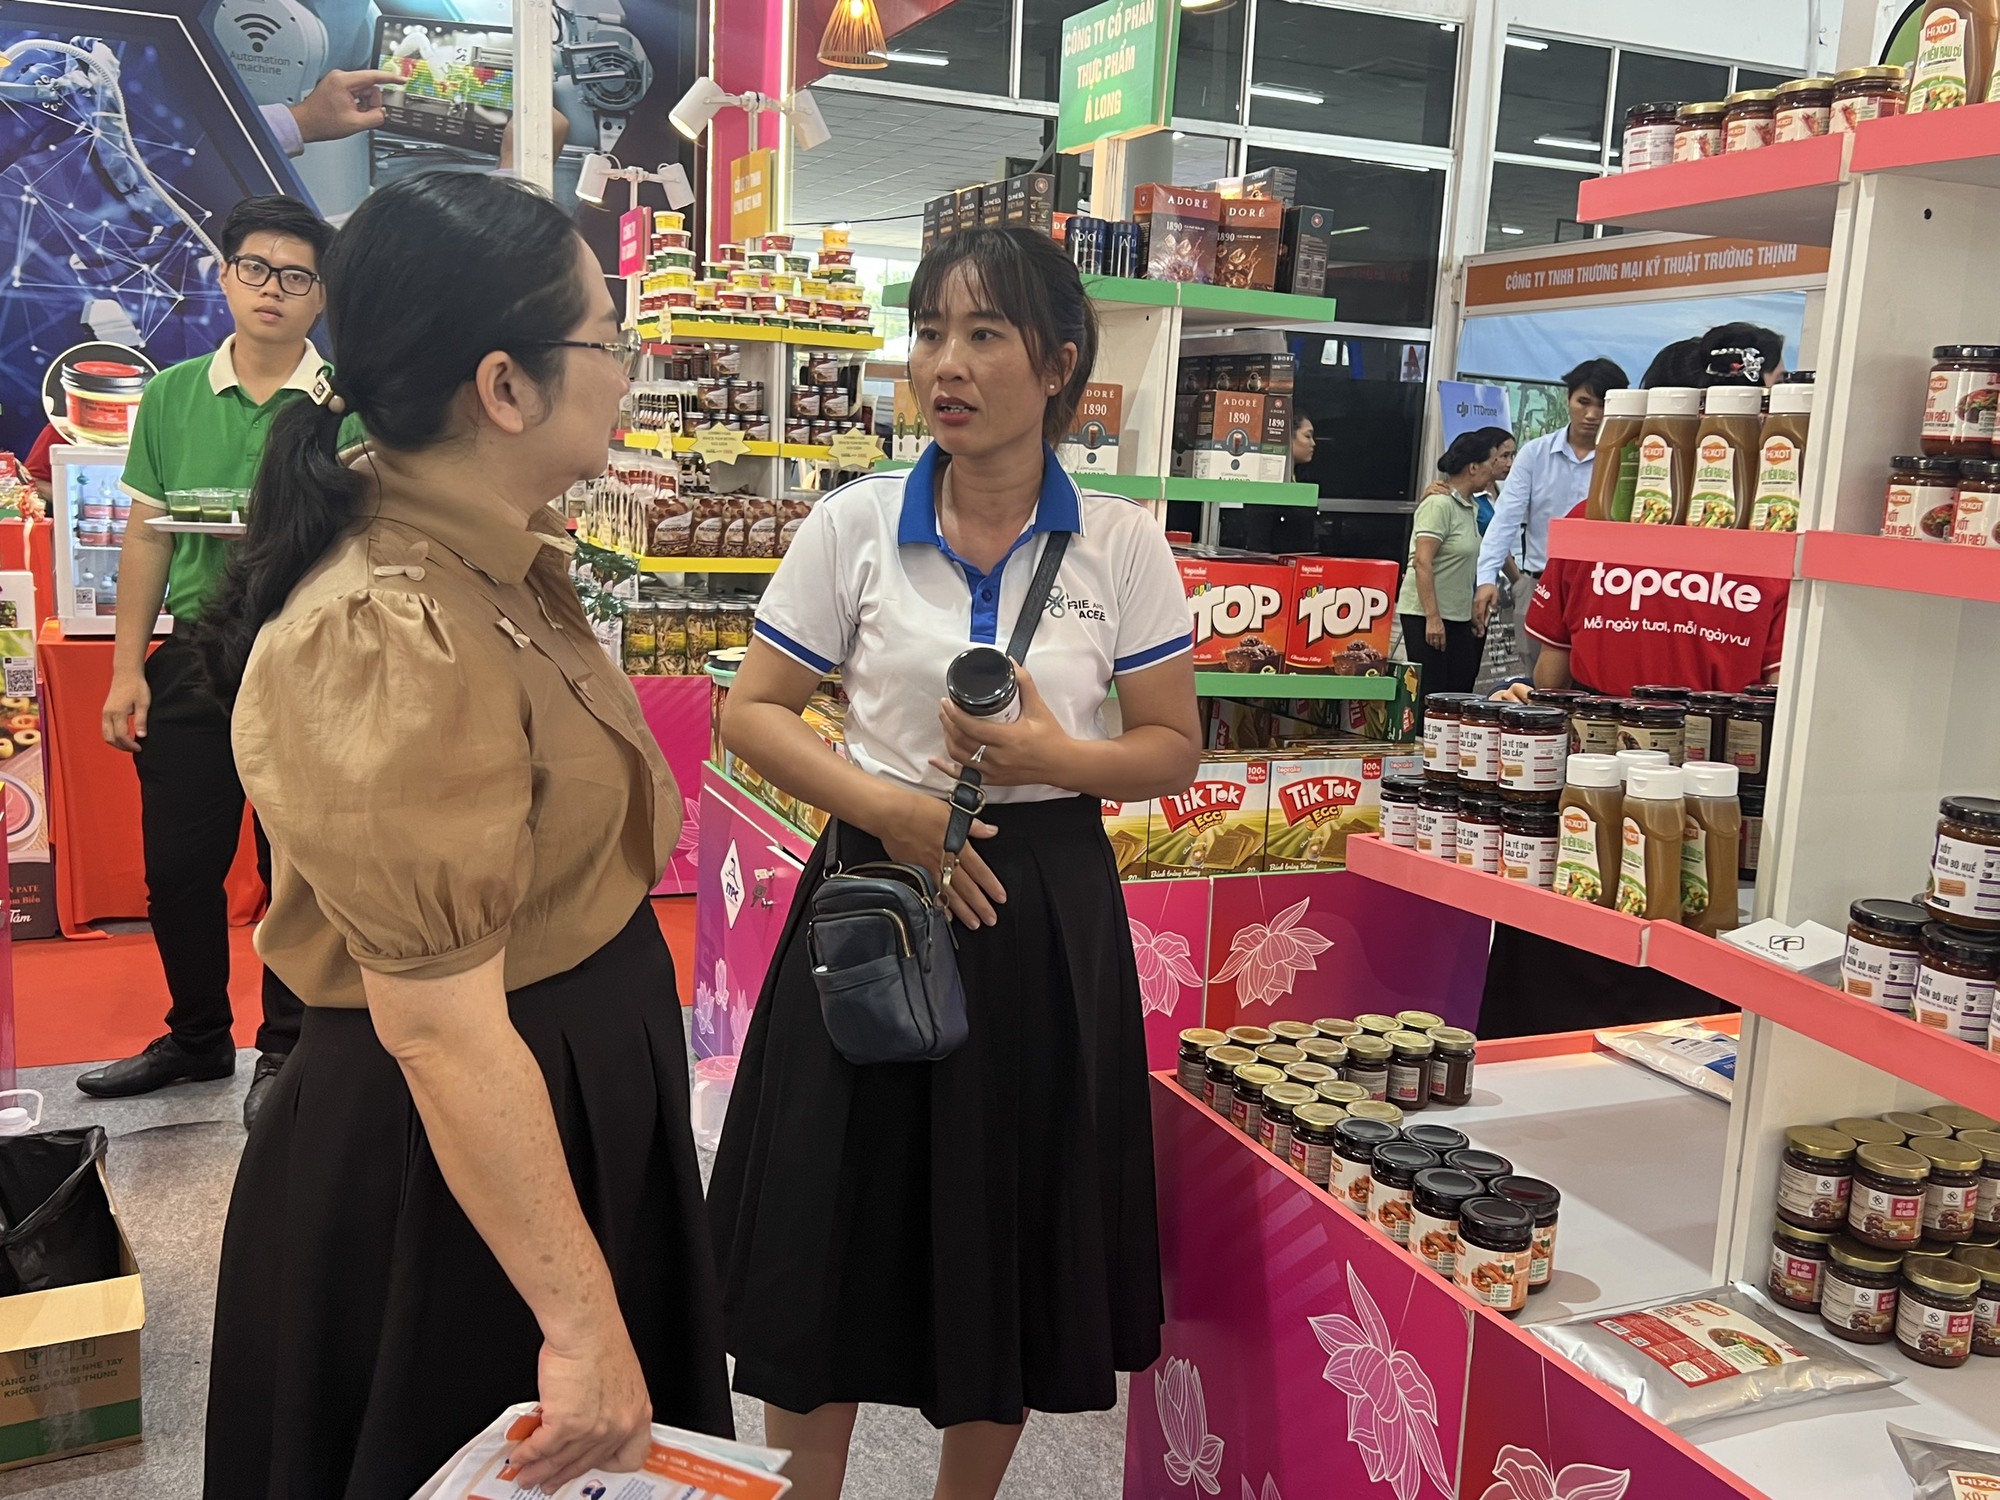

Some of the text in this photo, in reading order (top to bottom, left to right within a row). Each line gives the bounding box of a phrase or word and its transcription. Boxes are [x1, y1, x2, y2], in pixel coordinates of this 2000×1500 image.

[1065, 26, 1091, 57] CÔNG
[1094, 18, 1105, 45] TY
[231, 52, 290, 66] Automation
[237, 63, 282, 75] machine
[1094, 89, 1122, 121] LONG
[1168, 195, 1209, 210] ADORÉ
[1167, 221, 1183, 236] 1890
[1505, 271, 1532, 291] CÔNG
[1534, 270, 1546, 288] TY
[1548, 269, 1574, 287] TNHH
[1577, 264, 1618, 284] THƯƠNG
[1620, 264, 1643, 283] MẠI
[1663, 254, 1701, 278] THUẬT
[1704, 245, 1754, 271] TRƯỜNG
[1757, 243, 1798, 269] THỊNH
[1223, 397, 1257, 408] ADORÉ
[1083, 404, 1108, 417] 1890
[1228, 412, 1250, 424] 1890
[1268, 417, 1285, 428] 1890
[1590, 561, 1762, 613] topcake
[1187, 583, 1282, 648] TOP
[1297, 585, 1390, 649] TOP
[1605, 618, 1639, 633] ngày
[1641, 618, 1670, 634] tươi,
[1673, 620, 1697, 636] mỗi
[1699, 627, 1729, 642] ngày
[1729, 634, 1751, 648] vui
[1168, 782, 1240, 817] Tik Tok
[1285, 780, 1355, 811] Tik Tok
[1521, 841, 1535, 851] TÔM
[1942, 994, 1959, 1007] HUẾ
[105, 1357, 124, 1368] TAY
[4, 1384, 41, 1399] KHÔNG
